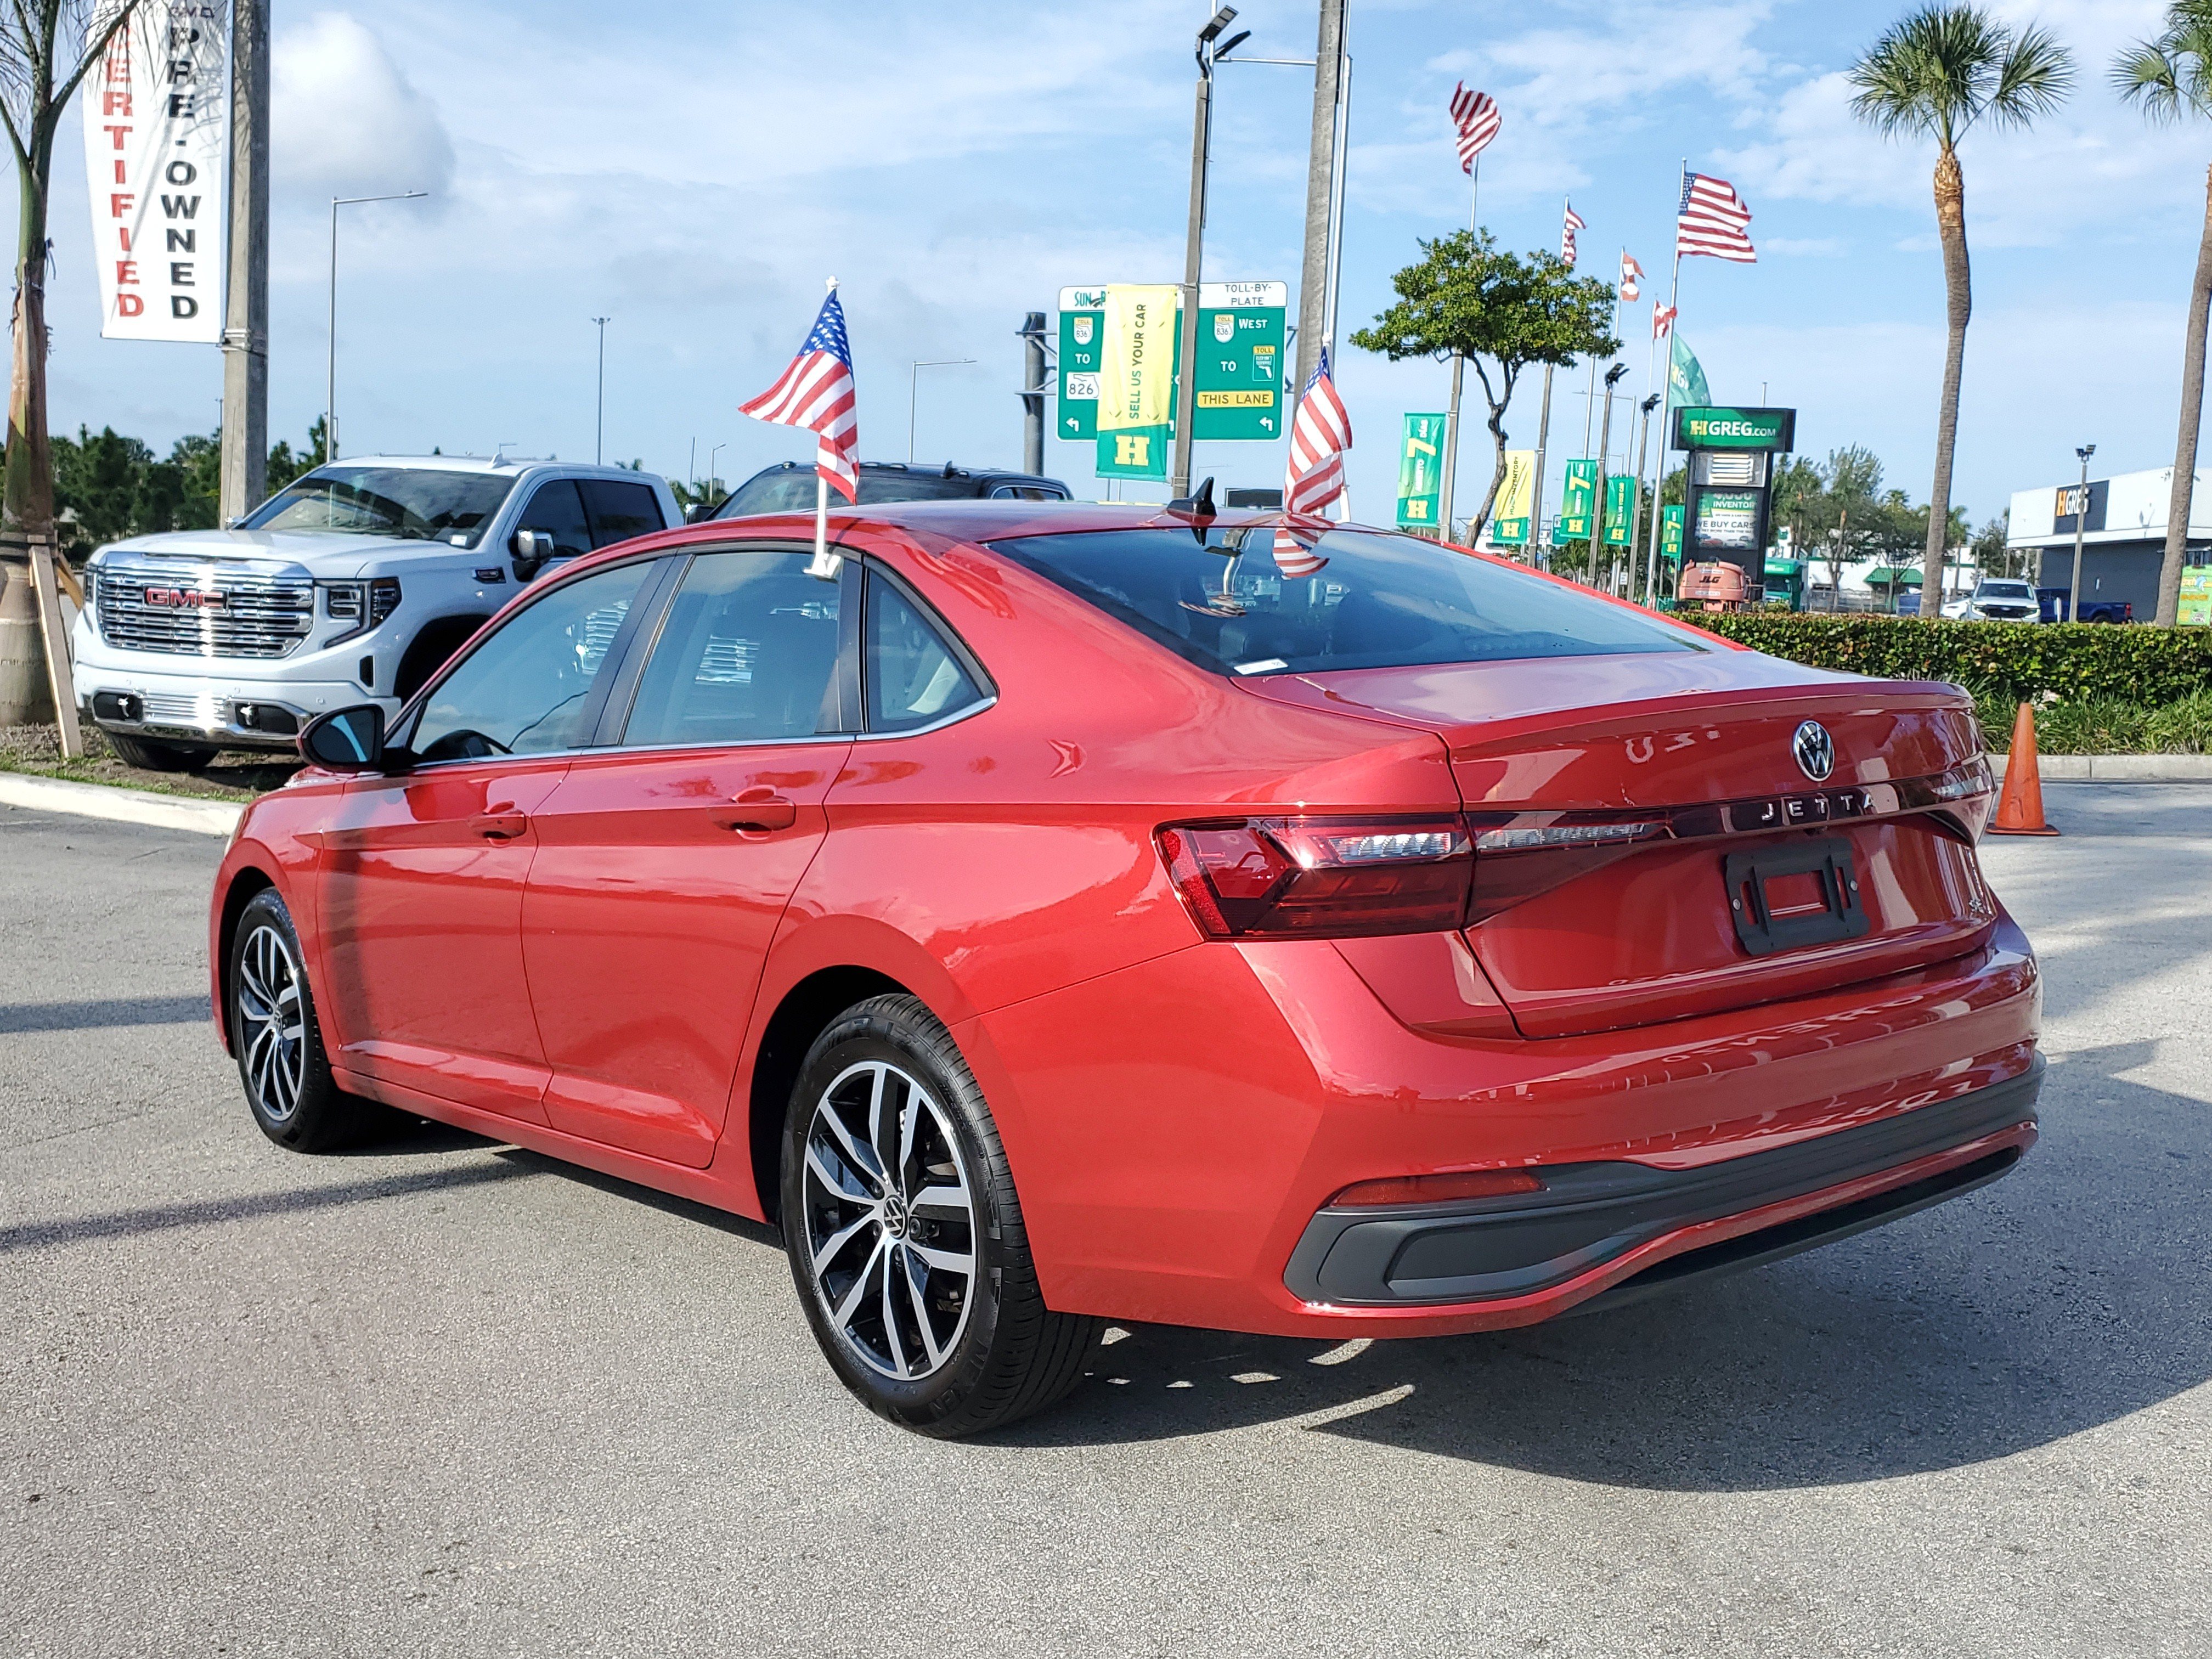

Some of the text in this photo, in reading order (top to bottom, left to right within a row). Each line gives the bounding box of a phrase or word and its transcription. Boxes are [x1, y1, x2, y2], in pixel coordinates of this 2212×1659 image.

[1225, 284, 1271, 293] TOLL-BY-
[1231, 297, 1264, 306] PLATE
[1075, 353, 1091, 365] TO
[1129, 303, 1147, 420] SELL US YOUR CAR
[1220, 361, 1237, 373] TO
[1069, 383, 1094, 396] 826
[1202, 394, 1269, 405] THIS LANE
[1407, 437, 1436, 458] 7
[1568, 476, 1590, 490] 7
[146, 588, 223, 608] GMC
[1762, 793, 1874, 821] JETTA
